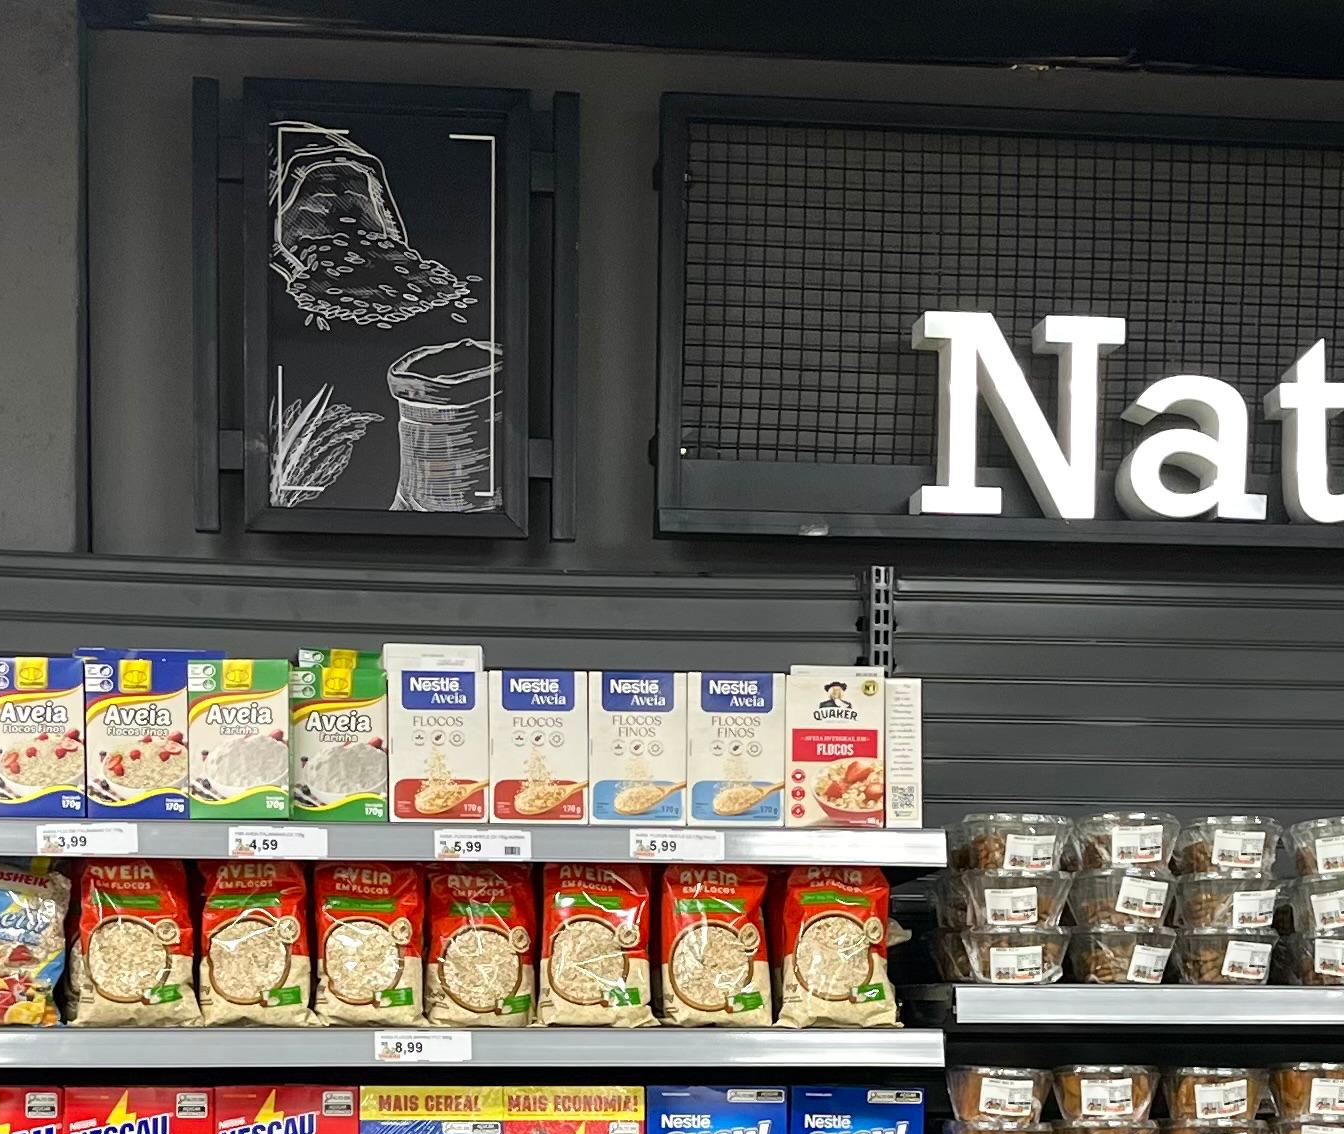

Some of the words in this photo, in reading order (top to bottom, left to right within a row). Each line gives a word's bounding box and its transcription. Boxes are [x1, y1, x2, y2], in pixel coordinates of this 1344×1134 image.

[410, 677, 459, 692] Nestlé
[609, 678, 659, 694] Nestlé
[431, 693, 466, 704] Aveia
[631, 694, 666, 707] Aveia
[0, 702, 68, 724] Aveia
[206, 703, 272, 725] Aveia
[814, 708, 858, 721] QUAKER
[413, 716, 463, 726] FLOCOS
[612, 715, 662, 727] FLOCOS
[219, 725, 259, 735] Farinha
[618, 726, 655, 737] FINOS
[817, 744, 854, 755] FLOCOS
[58, 835, 87, 849] 3,99
[249, 837, 278, 851] 4,59
[454, 840, 481, 853] 5,99
[650, 840, 677, 853] 5,99
[701, 885, 736, 895] FLOCOS
[395, 1041, 423, 1055] 8,99
[661, 1114, 710, 1129] Nestlé
